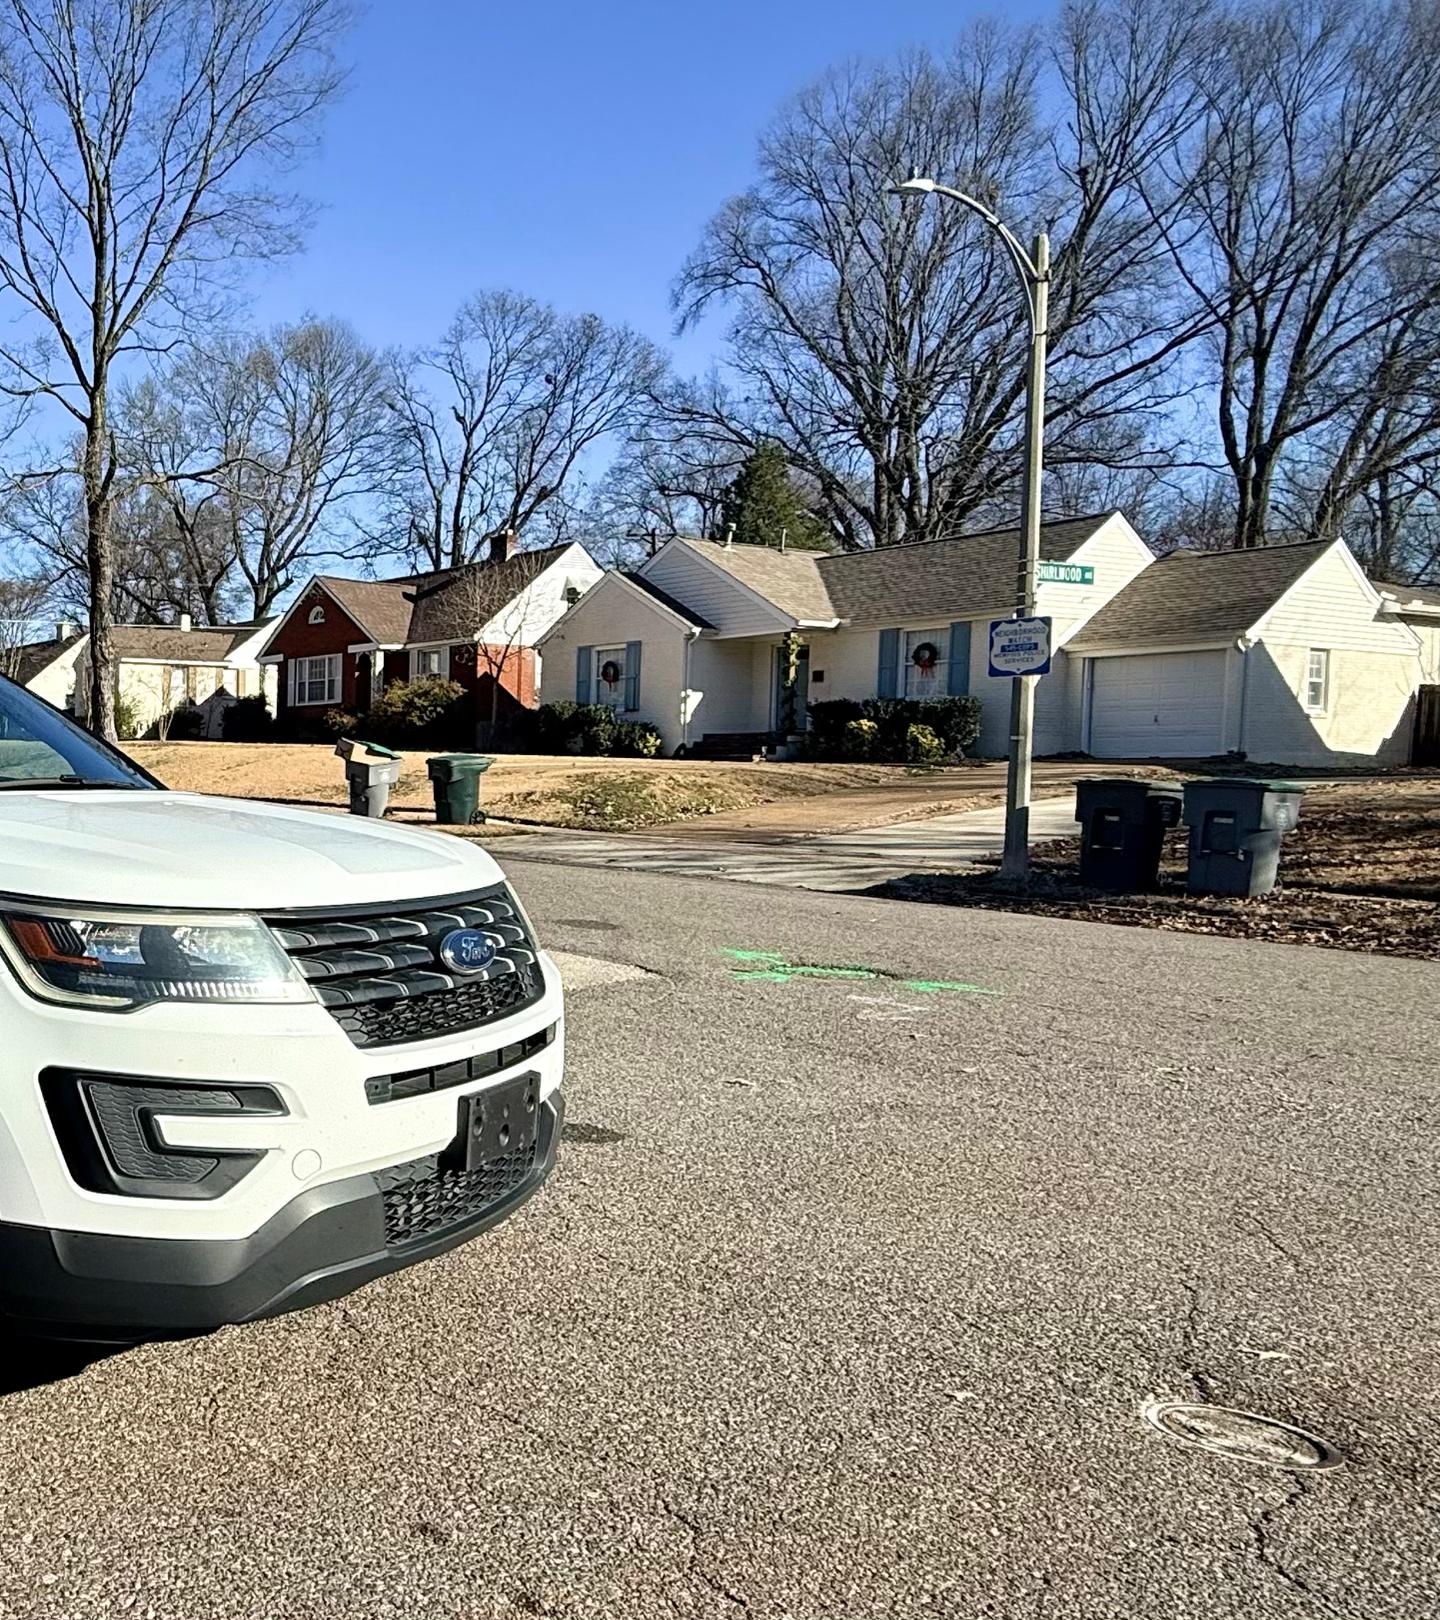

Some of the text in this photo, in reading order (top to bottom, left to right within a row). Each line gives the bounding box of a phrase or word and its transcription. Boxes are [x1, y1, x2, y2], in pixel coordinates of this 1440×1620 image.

[1034, 565, 1082, 582] SHIRLWOOD
[995, 627, 1046, 637] NEIGHBORHOOD
[1008, 635, 1033, 643] WATCH
[1004, 656, 1034, 664] SERVICES
[462, 936, 491, 962] Ford
